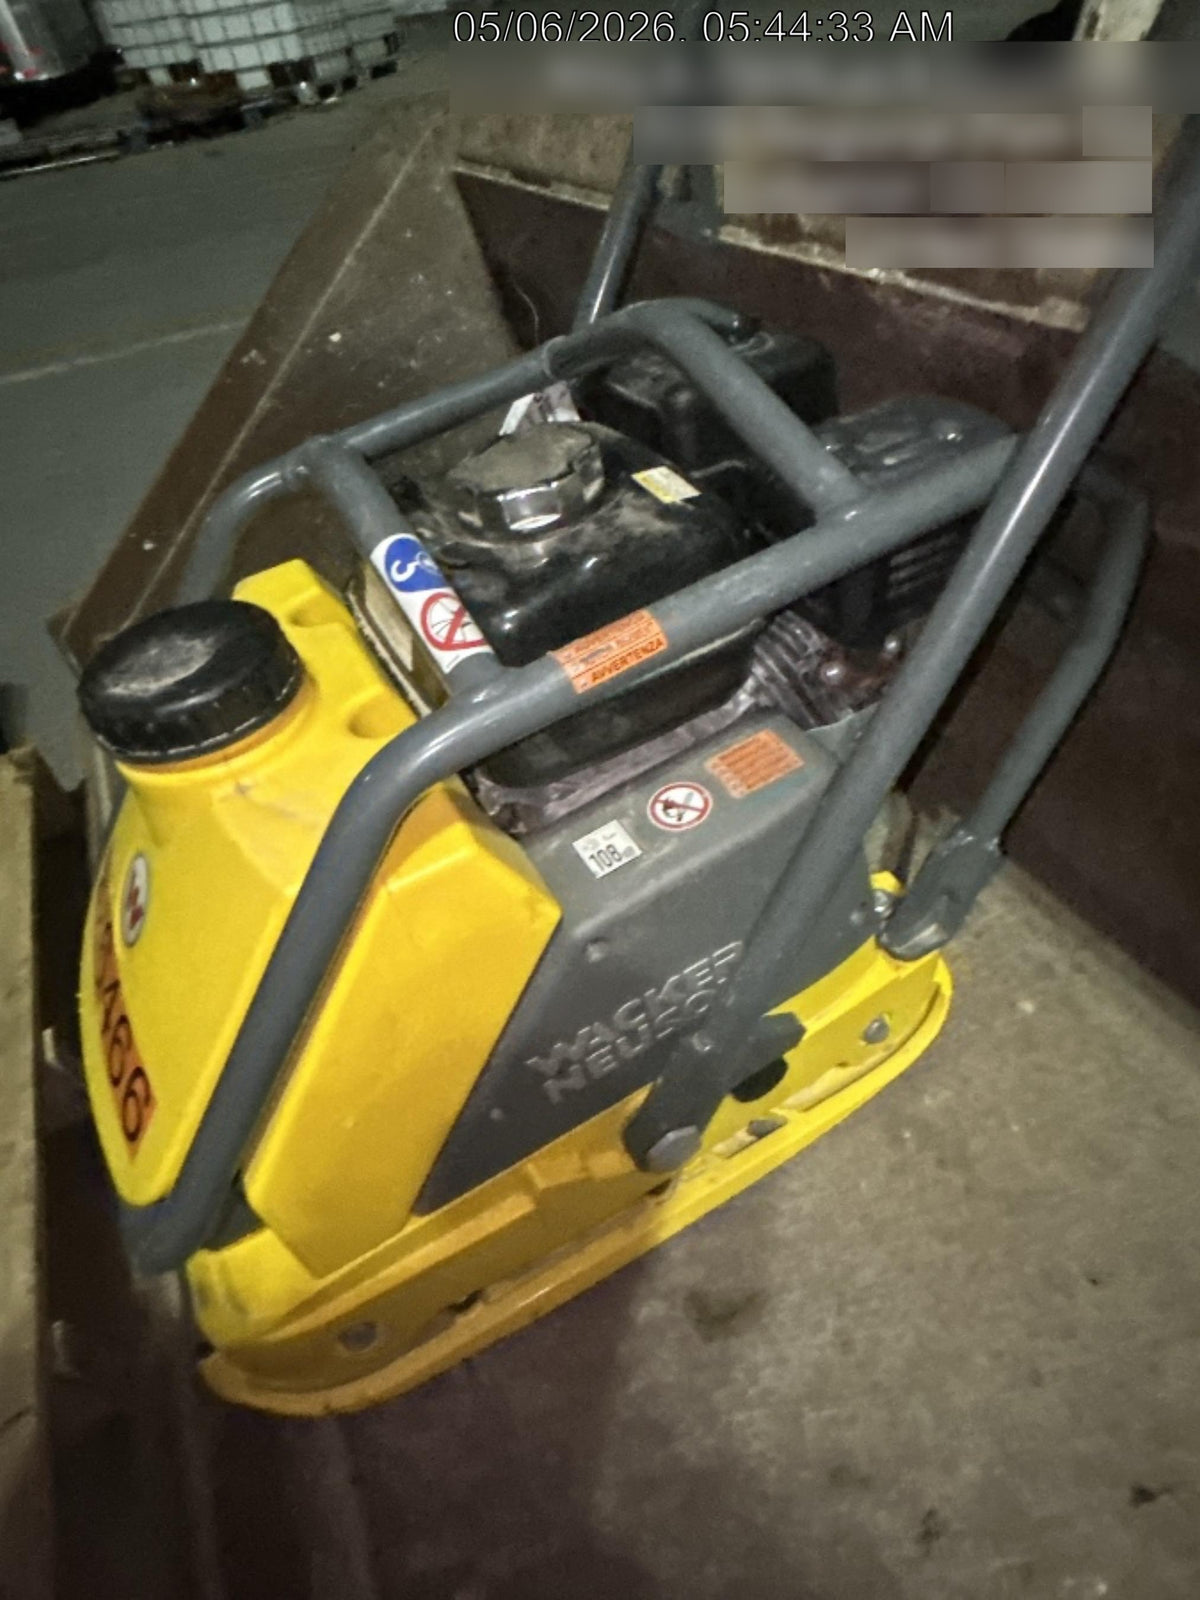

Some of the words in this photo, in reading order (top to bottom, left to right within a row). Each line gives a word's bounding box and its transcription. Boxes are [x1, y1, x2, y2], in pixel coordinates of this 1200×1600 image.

[591, 638, 663, 683] AVVERTENZA
[588, 843, 622, 872] 108
[526, 940, 743, 1077] WACKER
[543, 979, 730, 1104] NEUSO
